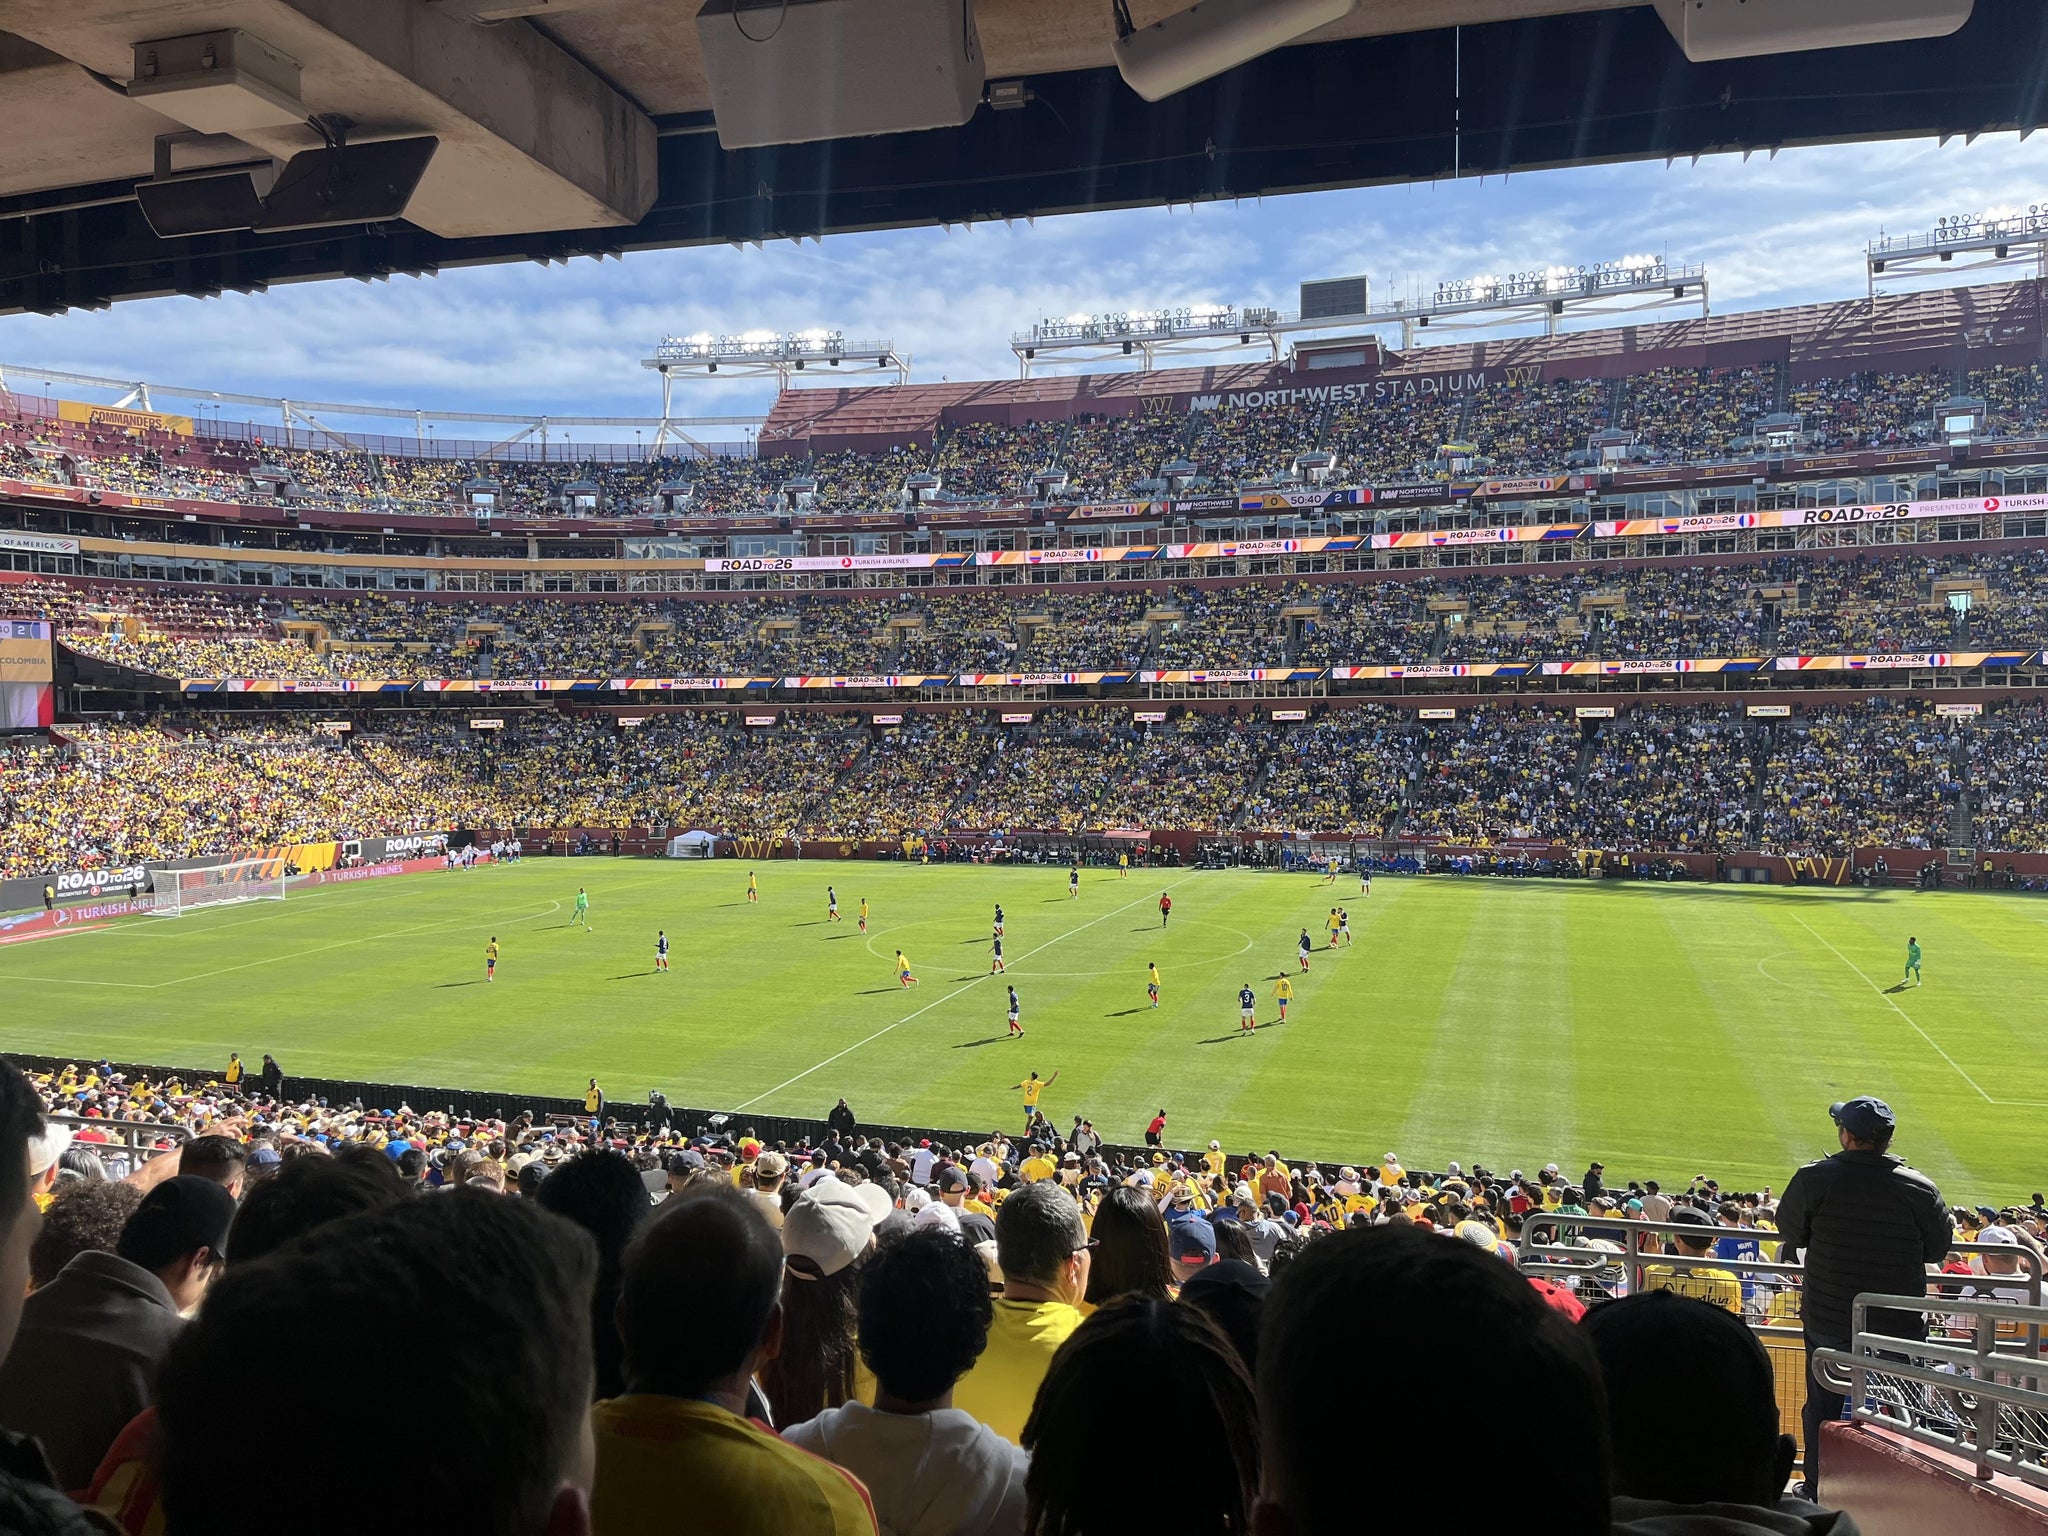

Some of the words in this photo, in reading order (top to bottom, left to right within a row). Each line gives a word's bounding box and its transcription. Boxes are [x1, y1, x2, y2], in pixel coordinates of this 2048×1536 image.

[1229, 383, 1370, 409] NORTHWEST
[1375, 373, 1485, 398] STADIUM
[92, 410, 162, 429] COMMANDERS
[1399, 486, 1443, 495] NORTHWEST
[1270, 498, 1278, 506] 0
[1290, 494, 1322, 505] 50:40
[1334, 494, 1342, 503] 2
[1803, 508, 1864, 523] ROAD
[1882, 504, 1909, 518] 26
[1920, 503, 1965, 513] PRESENTED
[1966, 502, 1979, 510] BY
[2004, 499, 2044, 507] TURKISH
[1682, 518, 1712, 526] ROAD
[1721, 516, 1735, 524] 26
[1450, 530, 1476, 539] ROAD
[17, 540, 55, 548] AMERICA
[1239, 542, 1264, 550] ROAD
[1044, 550, 1067, 558] ROAD
[721, 559, 762, 571] ROAD
[774, 559, 793, 569] 26
[18, 626, 25, 635] 2
[1870, 655, 1902, 663] ROAD
[1910, 654, 1925, 662] 26
[386, 837, 422, 851] ROAD
[432, 834, 449, 846] 26
[57, 870, 108, 890] ROAD
[109, 874, 122, 884] TO
[122, 866, 145, 882] 26
[332, 867, 368, 882] TURKISH
[369, 865, 403, 877] AIRLINES
[57, 890, 82, 898] PRESENTED
[76, 903, 127, 920] TURKISH
[1244, 994, 1250, 1003] 3
[1027, 1085, 1032, 1096] 2
[1157, 1182, 1166, 1193] 10
[1324, 1206, 1339, 1222] 10
